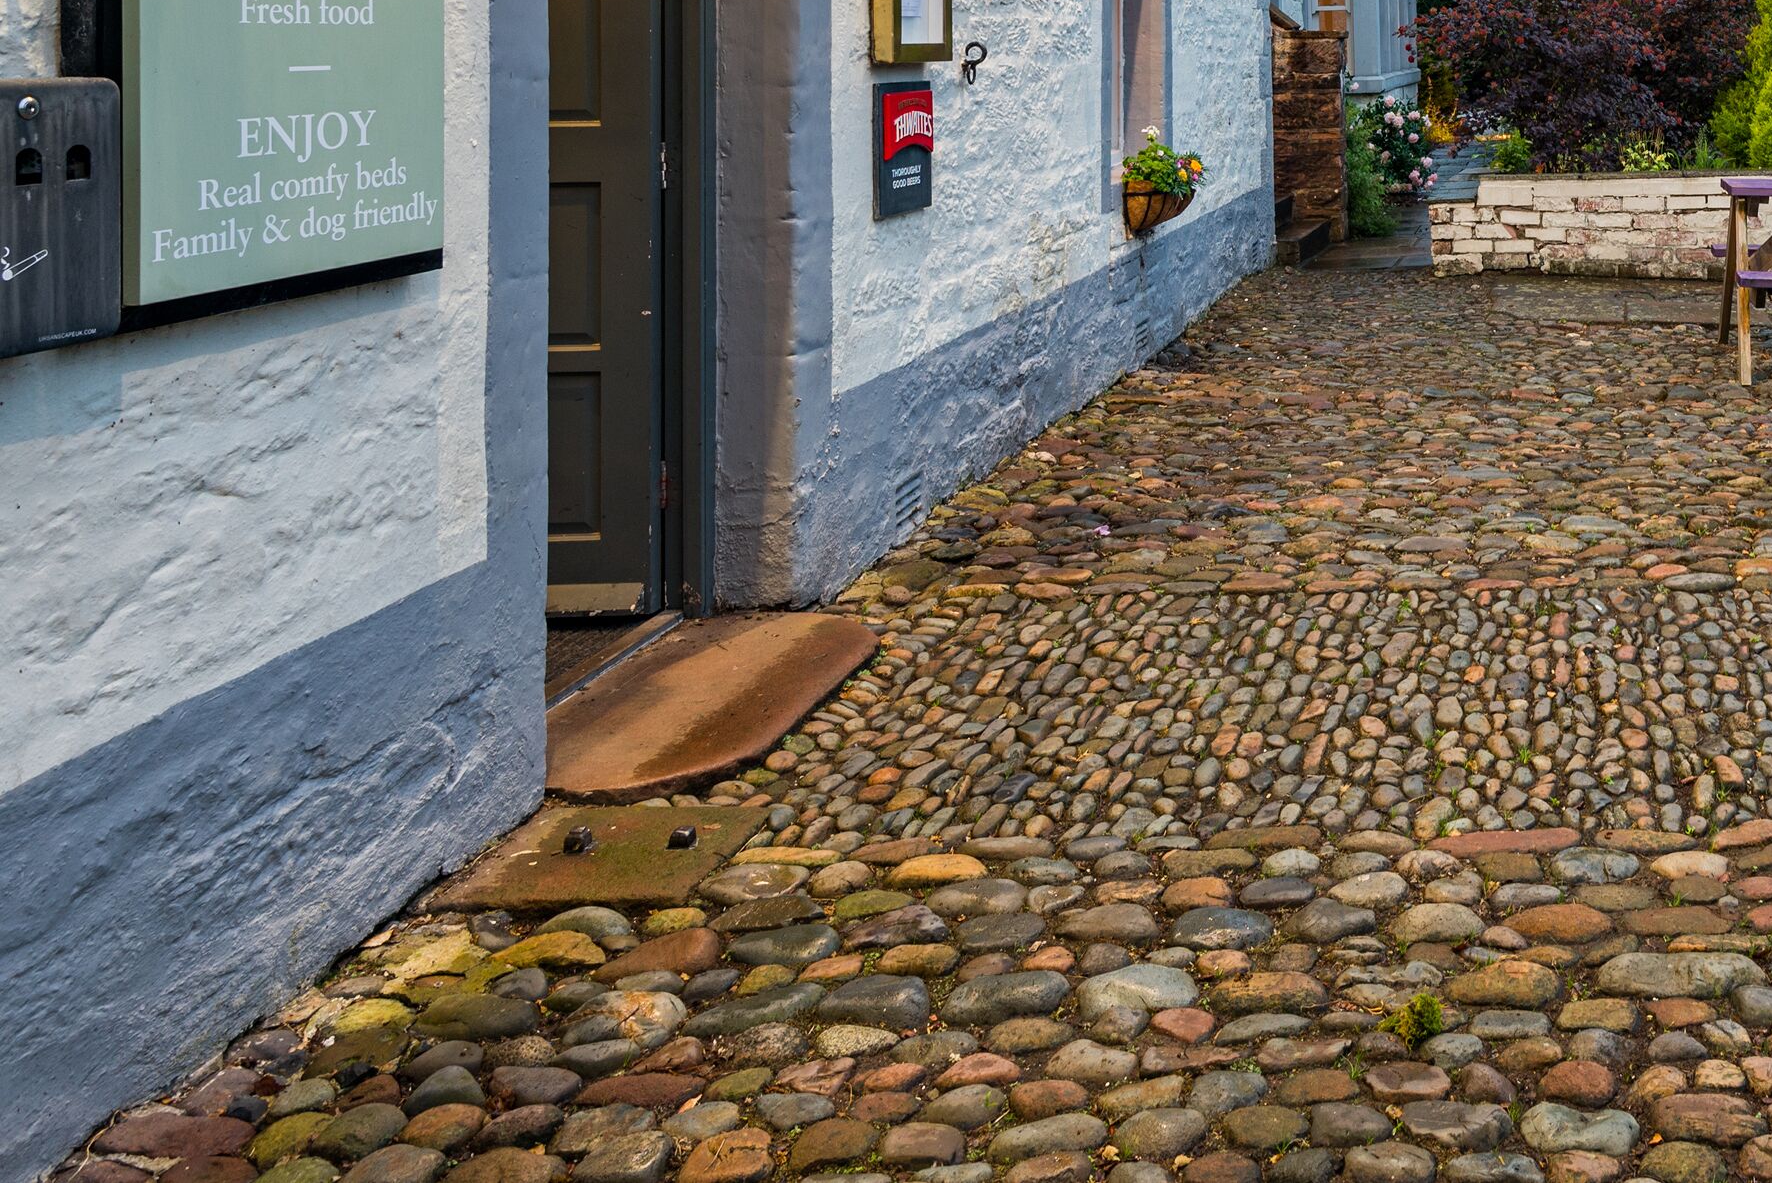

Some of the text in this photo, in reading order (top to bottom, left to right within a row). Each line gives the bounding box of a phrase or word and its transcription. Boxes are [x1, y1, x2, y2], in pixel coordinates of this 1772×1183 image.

[236, 109, 377, 164] ENJOY
[894, 111, 932, 143] THWAITES
[197, 156, 408, 212] Real comfy beds
[892, 165, 921, 177] THOROUGHLY
[893, 176, 921, 189] GOOD BEERS
[151, 190, 439, 264] Family & dog friendly
